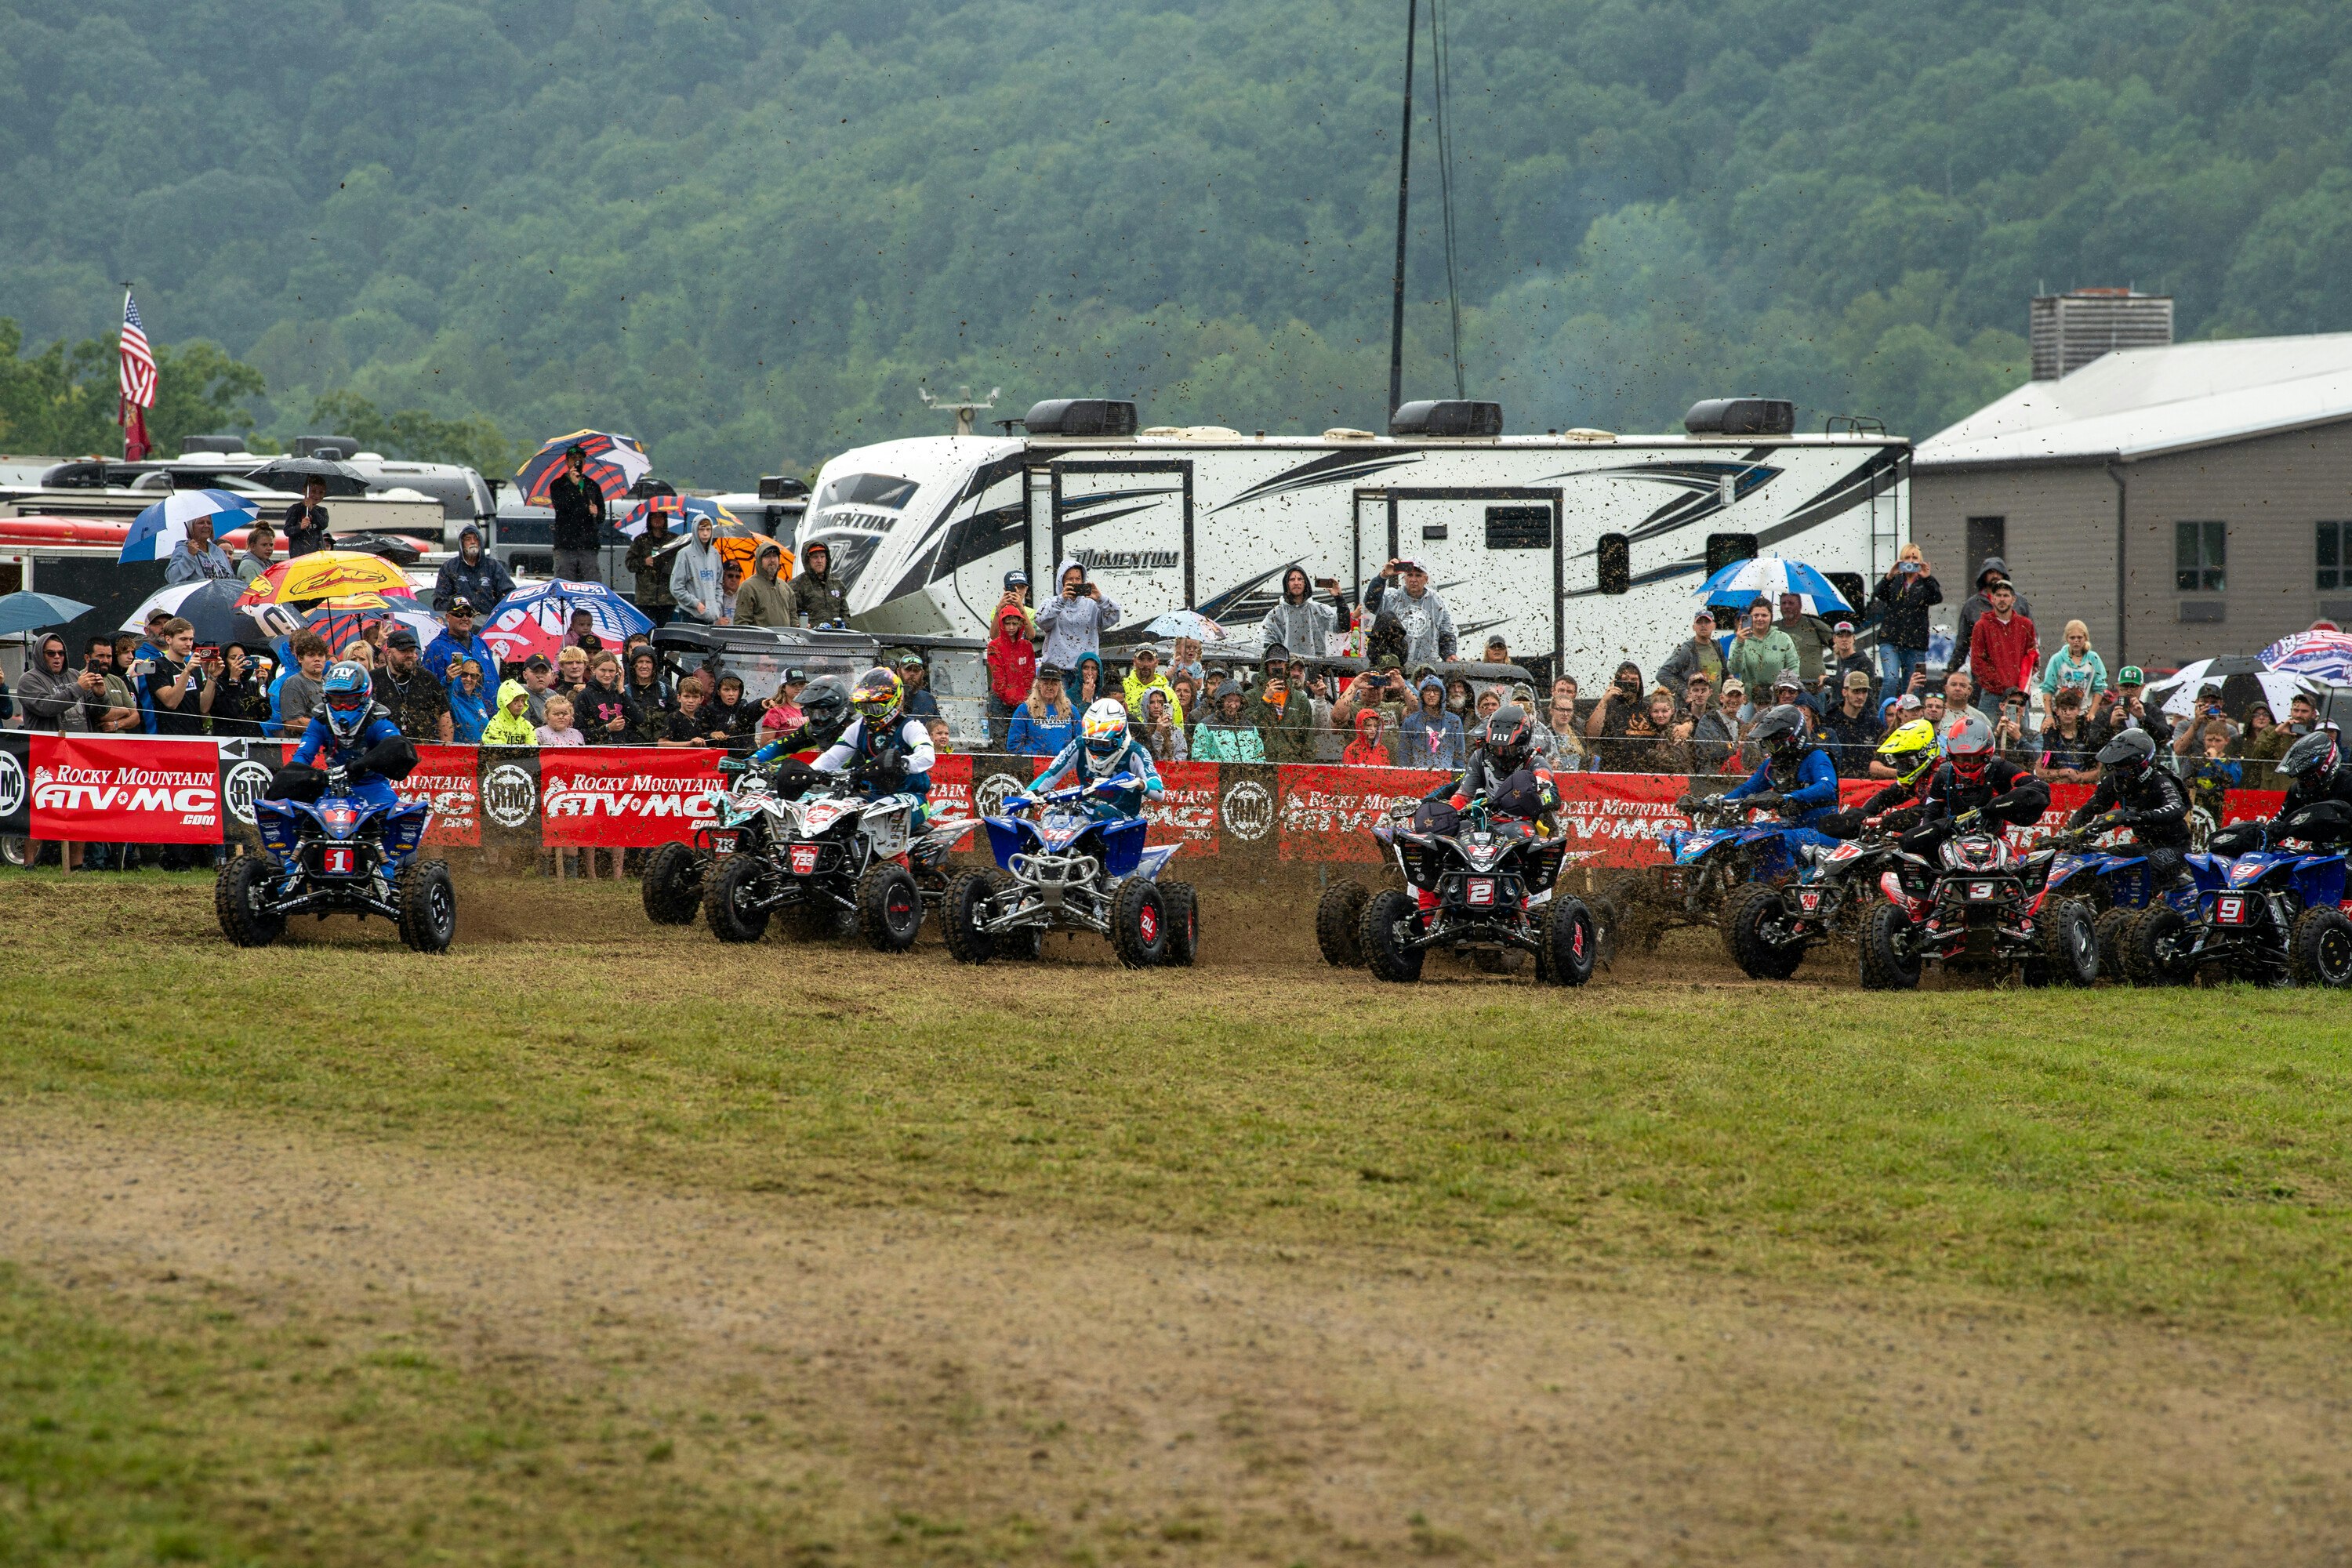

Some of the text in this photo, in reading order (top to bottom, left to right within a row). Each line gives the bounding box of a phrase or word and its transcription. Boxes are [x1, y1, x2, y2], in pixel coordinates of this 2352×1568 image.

[332, 668, 354, 677] FLY
[1492, 733, 1509, 742] FLY
[56, 764, 215, 787] ROCKY MOUNTAIN
[571, 774, 724, 793] ROCKY MOUNTAIN
[332, 851, 346, 871] 1
[793, 852, 815, 866] 733
[1469, 884, 1492, 902] 2
[1969, 881, 1994, 899] 3
[277, 896, 309, 910] HOUSER
[369, 898, 401, 915] HOUSER
[1803, 895, 1818, 909] 241
[2220, 899, 2242, 918] 9
